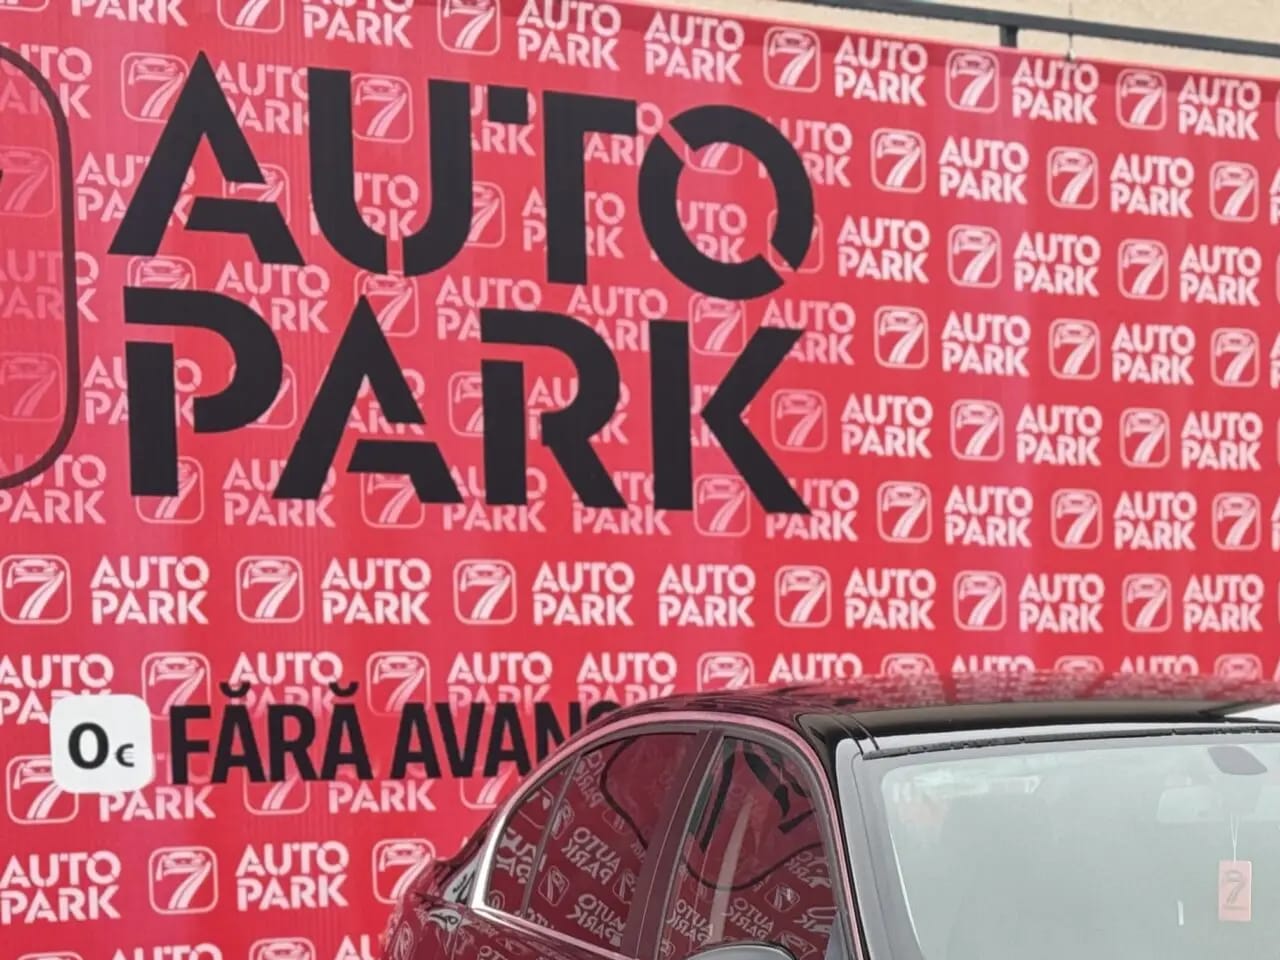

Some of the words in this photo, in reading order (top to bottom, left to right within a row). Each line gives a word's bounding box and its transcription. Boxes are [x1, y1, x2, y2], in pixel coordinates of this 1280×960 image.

[304, 8, 411, 48] PARK
[517, 0, 622, 38] AUTO
[644, 12, 744, 52] AUTO
[518, 29, 618, 70] PARK
[646, 47, 741, 84] PARK
[834, 37, 927, 74] AUTO
[835, 66, 925, 106] PARK
[1012, 58, 1098, 93] AUTO
[1012, 86, 1096, 124] PARK
[1178, 78, 1260, 110] AUTO
[1178, 102, 1260, 140] PARK
[939, 137, 1029, 173] AUTO
[1110, 154, 1194, 188] AUTO
[107, 50, 814, 300] AUTO
[940, 168, 1028, 204] PARK
[1110, 182, 1194, 218] PARK
[838, 217, 930, 253] AUTO
[1014, 232, 1100, 267] AUTO
[215, 261, 330, 297] AUTO
[839, 247, 929, 283] PARK
[1014, 261, 1099, 296] PARK
[1180, 245, 1261, 279] AUTO
[436, 275, 541, 311] AUTO
[567, 285, 668, 318] AUTO
[1180, 273, 1260, 306] PARK
[761, 299, 856, 333] AUTO
[942, 312, 1030, 346] AUTO
[1112, 324, 1195, 357] AUTO
[942, 341, 1030, 376] PARK
[1112, 352, 1194, 384] PARK
[123, 285, 812, 514] PARK
[842, 394, 933, 429] AUTO
[1016, 405, 1102, 438] AUTO
[1181, 411, 1262, 443] AUTO
[843, 425, 931, 458] PARK
[1016, 434, 1100, 466] PARK
[1181, 438, 1261, 470] PARK
[224, 498, 335, 527] PARK
[443, 503, 546, 532] PARK
[945, 486, 1033, 519] AUTO
[1114, 492, 1197, 523] AUTO
[573, 505, 671, 536] PARK
[767, 511, 858, 541] PARK
[945, 514, 1032, 547] PARK
[1114, 518, 1195, 550] PARK
[91, 556, 209, 592] AUTO
[321, 558, 431, 591] AUTO
[532, 562, 634, 594] AUTO
[658, 564, 755, 596] AUTO
[845, 568, 936, 602] AUTO
[1019, 574, 1104, 605] AUTO
[1183, 574, 1264, 607] AUTO
[92, 589, 208, 624] PARK
[323, 590, 429, 624] PARK
[534, 593, 633, 625] PARK
[658, 594, 753, 626] PARK
[845, 597, 934, 629] PARK
[1019, 602, 1102, 632] PARK
[1183, 603, 1262, 632] PARK
[0, 654, 114, 690] AUTO
[229, 651, 343, 688] AUTO
[448, 652, 552, 686] AUTO
[577, 652, 677, 685] AUTO
[769, 653, 862, 682] AUTO
[168, 682, 374, 785] FĂRĂ
[391, 701, 622, 782] AVAN
[99, 788, 214, 821] PARK
[329, 778, 436, 813] PARK
[0, 851, 121, 890] AUTO
[236, 841, 349, 878] AUTO
[0, 887, 120, 924] PARK
[238, 873, 348, 911] PARK
